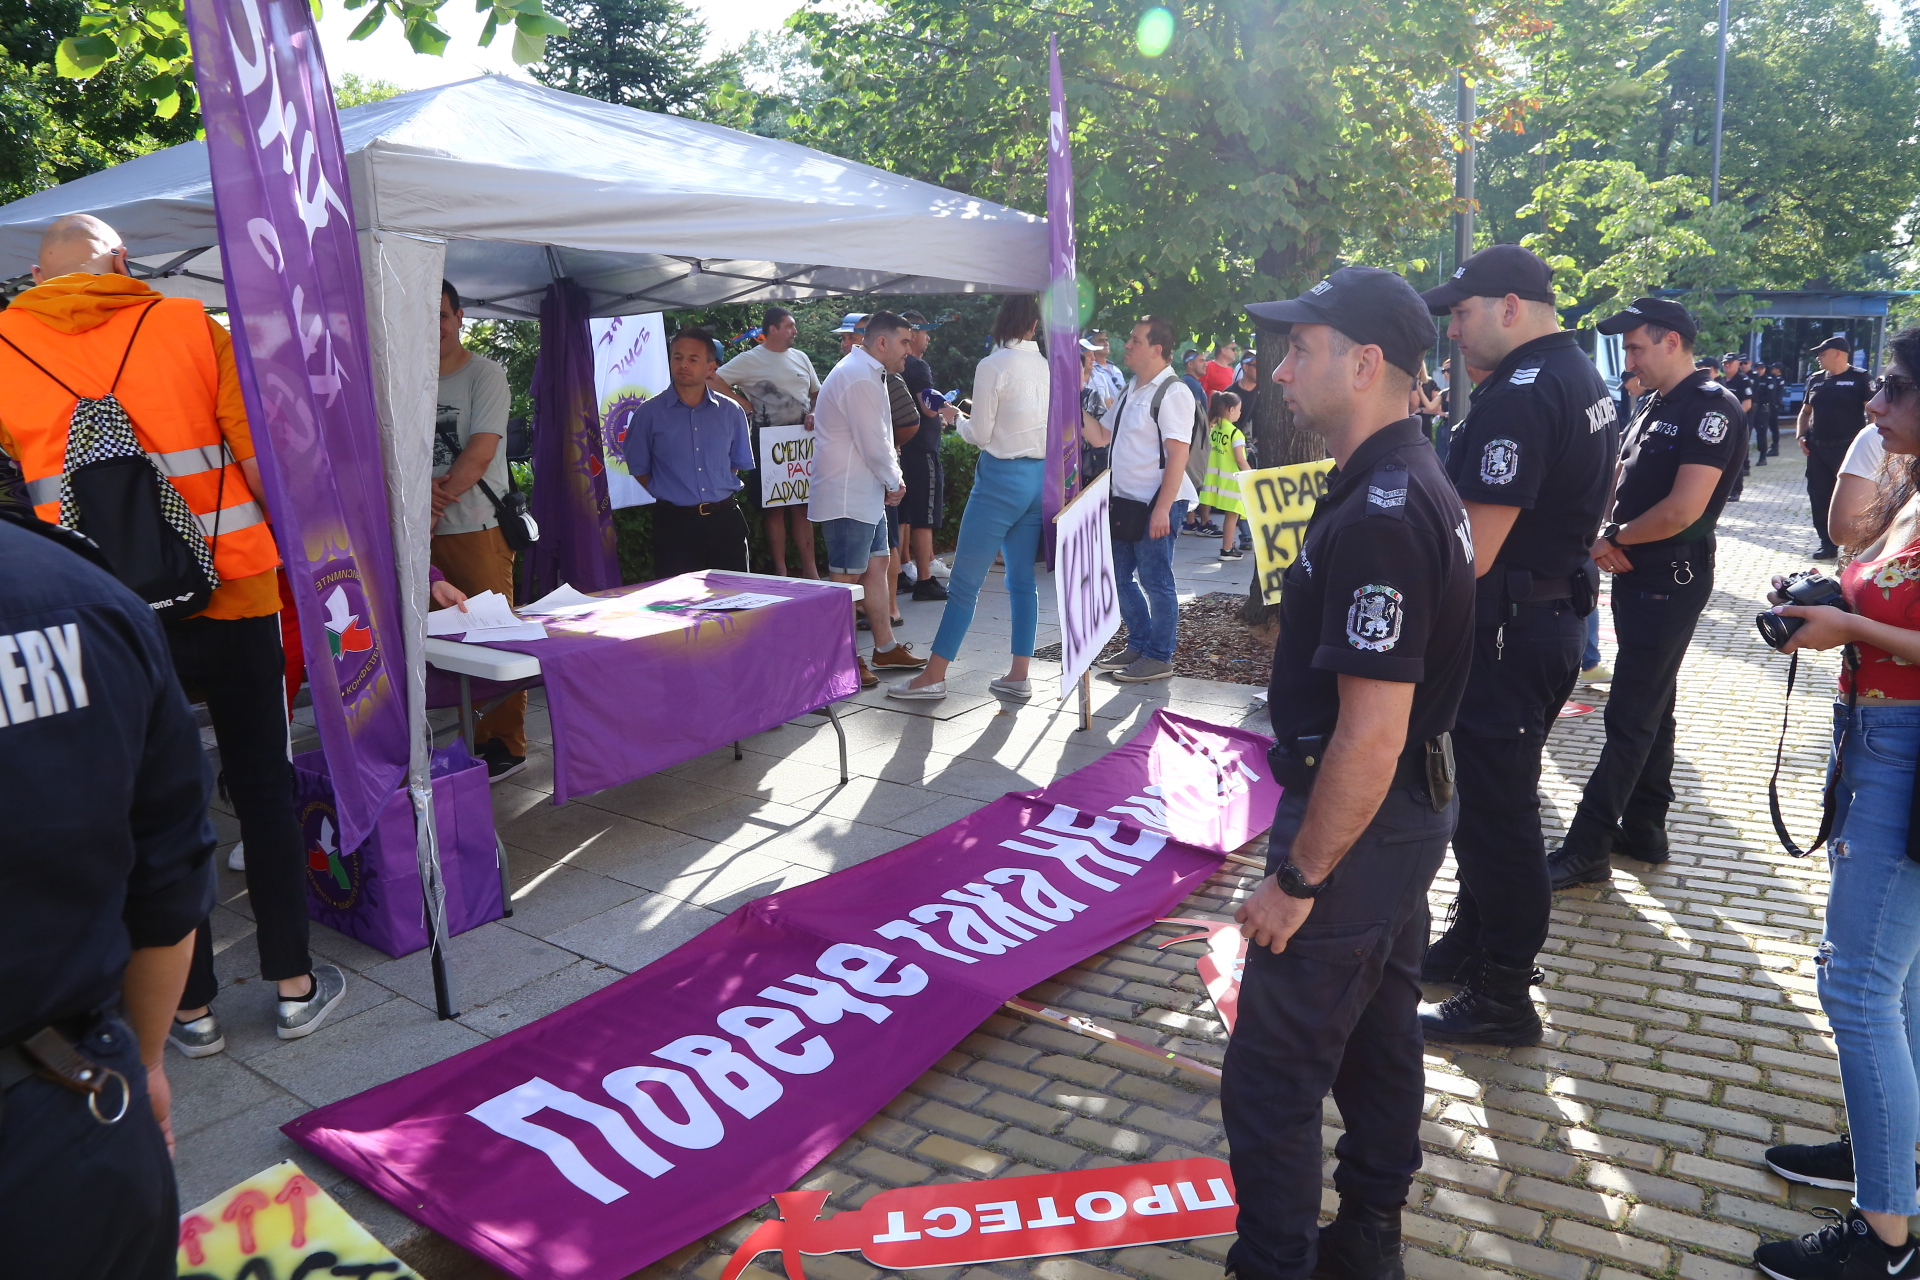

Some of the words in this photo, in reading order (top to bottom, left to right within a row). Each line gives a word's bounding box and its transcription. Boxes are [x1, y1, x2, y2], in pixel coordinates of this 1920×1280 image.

[771, 436, 816, 466] СМЕТКИ
[1061, 497, 1115, 674] КНСБ
[0, 623, 90, 728] ERY
[997, 803, 1171, 893] НЕ
[872, 1177, 1235, 1244] ПРОТЕСТ
